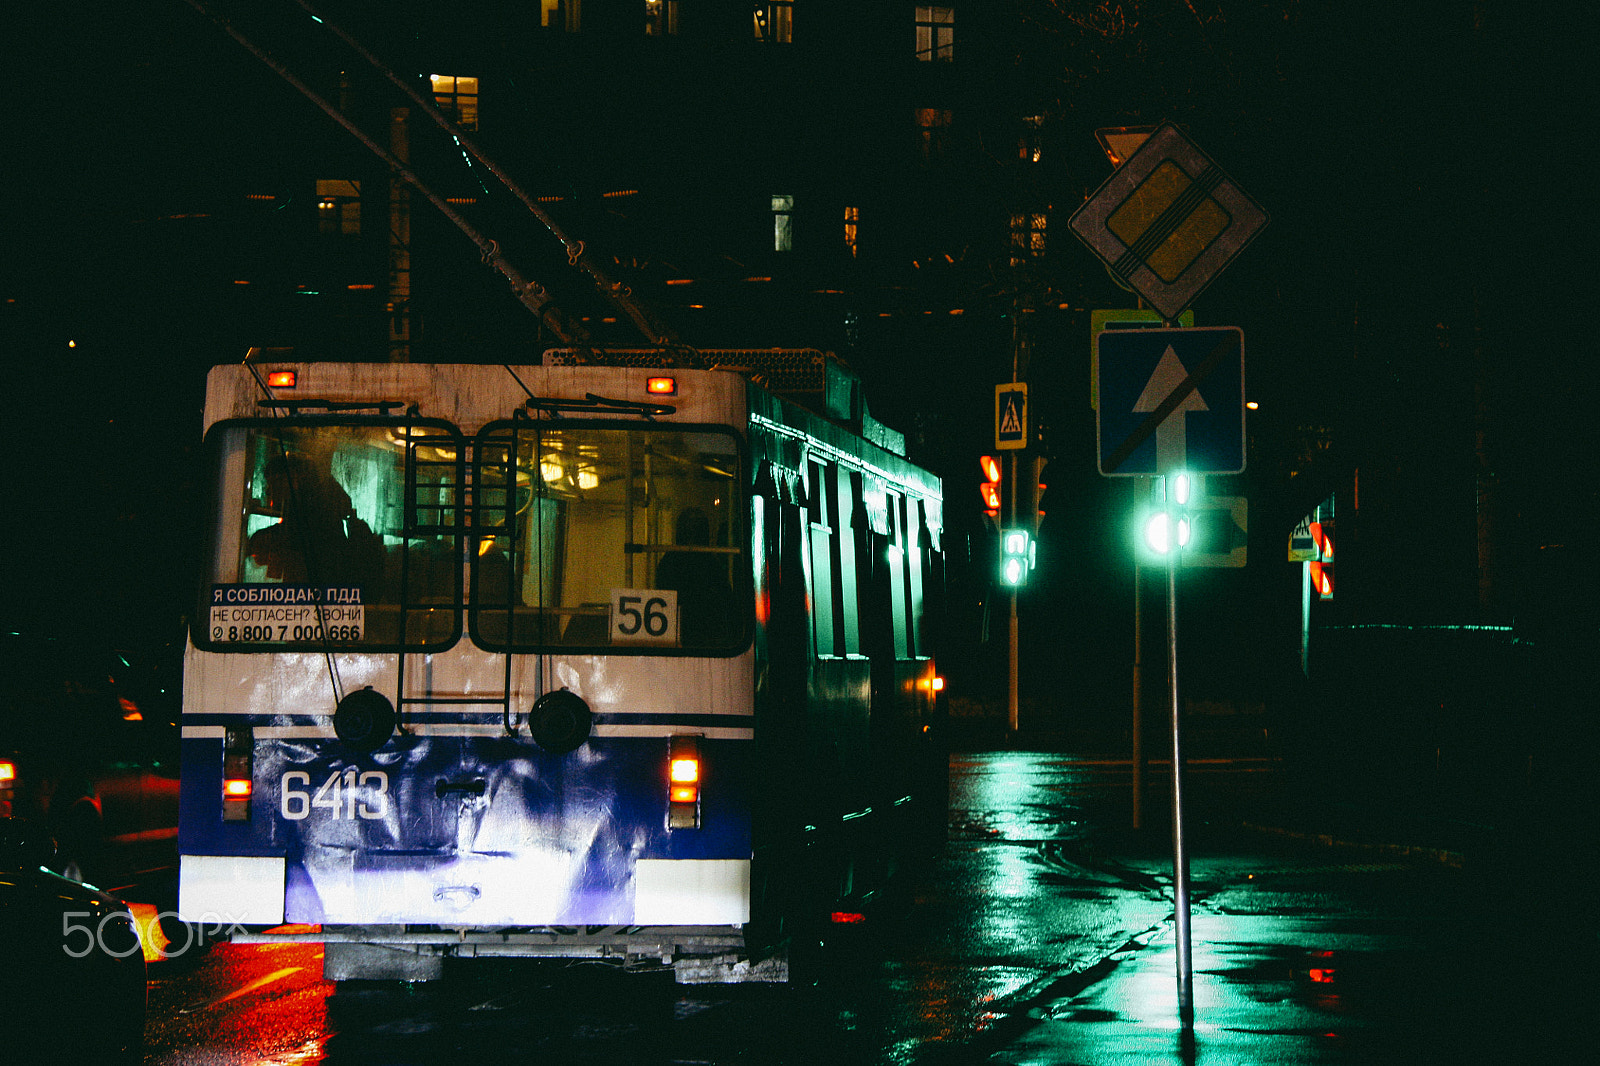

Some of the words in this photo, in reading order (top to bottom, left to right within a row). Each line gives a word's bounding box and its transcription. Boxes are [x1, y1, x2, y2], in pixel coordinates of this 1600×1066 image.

[214, 589, 223, 602] Я
[327, 588, 361, 604] ПДД
[213, 609, 228, 621] НЕ
[232, 609, 310, 621] СОГЛАСЕН?
[618, 596, 668, 636] 56
[228, 626, 238, 641] 8
[243, 626, 273, 641] 800
[277, 626, 288, 641] 7
[293, 625, 322, 640] 000
[329, 625, 360, 640] 666
[281, 770, 389, 820] 6413
